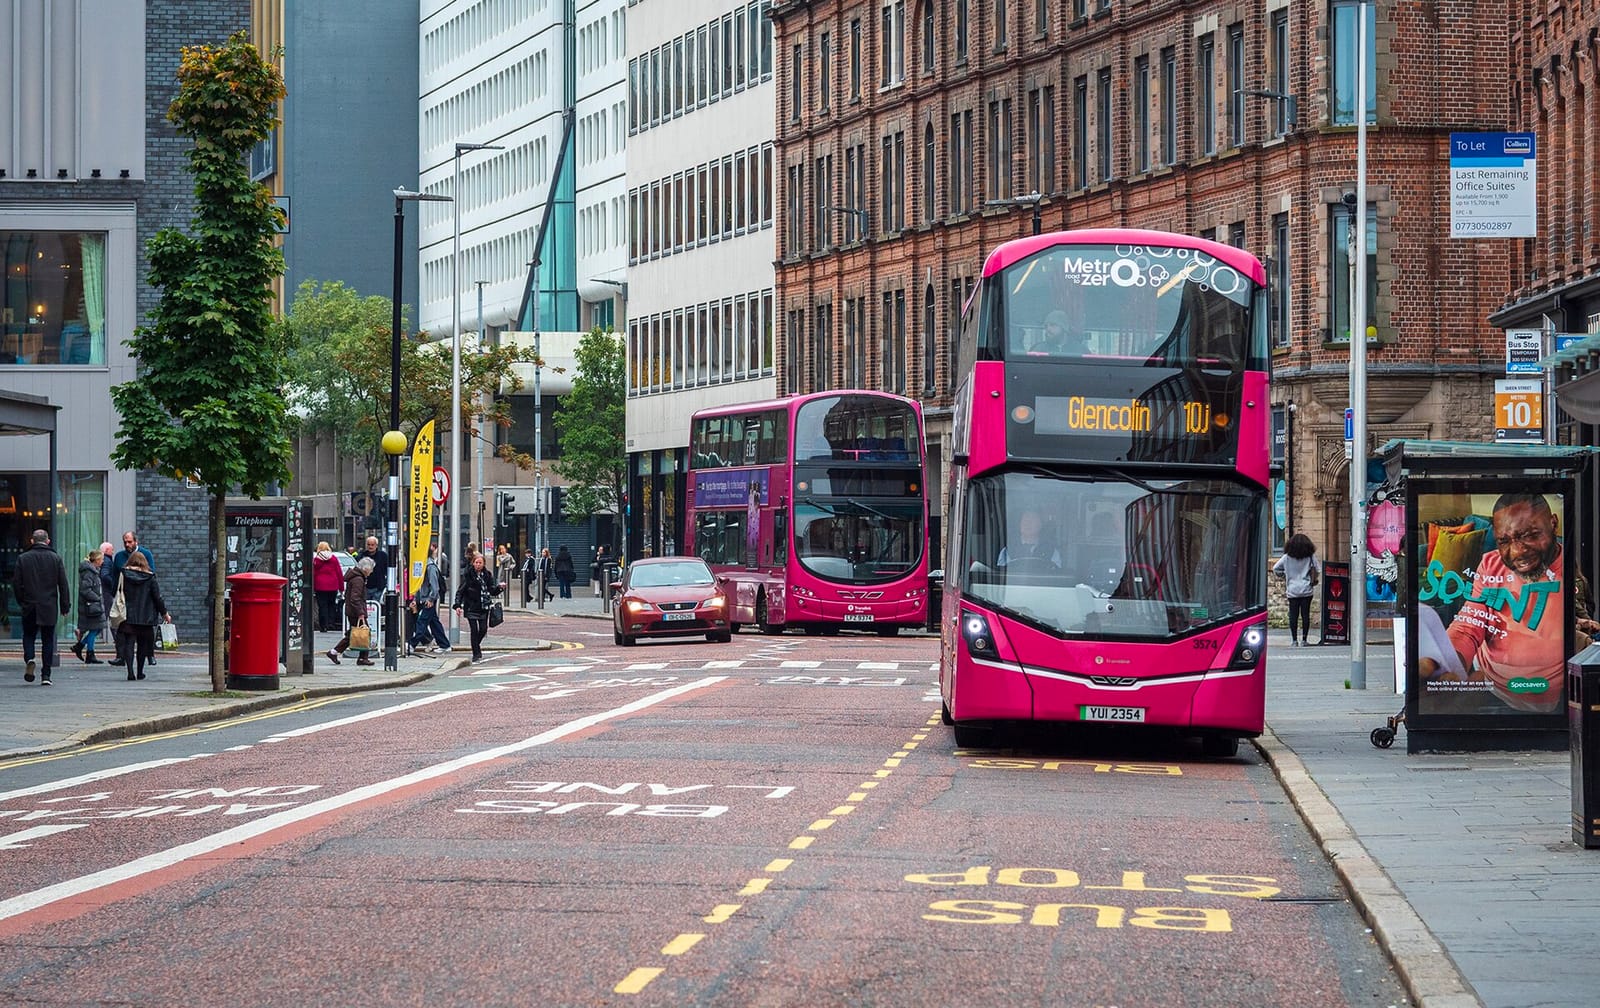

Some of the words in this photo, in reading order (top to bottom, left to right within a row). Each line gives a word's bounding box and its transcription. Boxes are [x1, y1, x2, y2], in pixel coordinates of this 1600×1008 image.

[1456, 141, 1468, 150] To
[1471, 141, 1486, 151] Let
[1506, 140, 1528, 148] Colliers
[1456, 171, 1475, 179] Last
[1478, 170, 1529, 181] Remaining
[1456, 182, 1484, 191] Office
[1487, 182, 1516, 191] Suites
[1456, 222, 1512, 230] 07730502897
[1523, 341, 1539, 349] Stop
[1069, 396, 1149, 431] Glencolin
[1503, 402, 1531, 427] 10
[235, 516, 273, 526] Telephone
[1463, 567, 1480, 580] Are
[1481, 574, 1504, 584] you
[1506, 575, 1515, 583] a
[1418, 560, 1560, 631] SQUINT
[1193, 640, 1217, 649] 3574
[1090, 708, 1108, 719] YUI
[1111, 709, 1140, 720] 2354
[968, 759, 1183, 776] BUS
[475, 781, 795, 799] LANE
[454, 800, 729, 818] BUS
[904, 866, 1281, 898] STOP
[921, 899, 1233, 932] BUS
